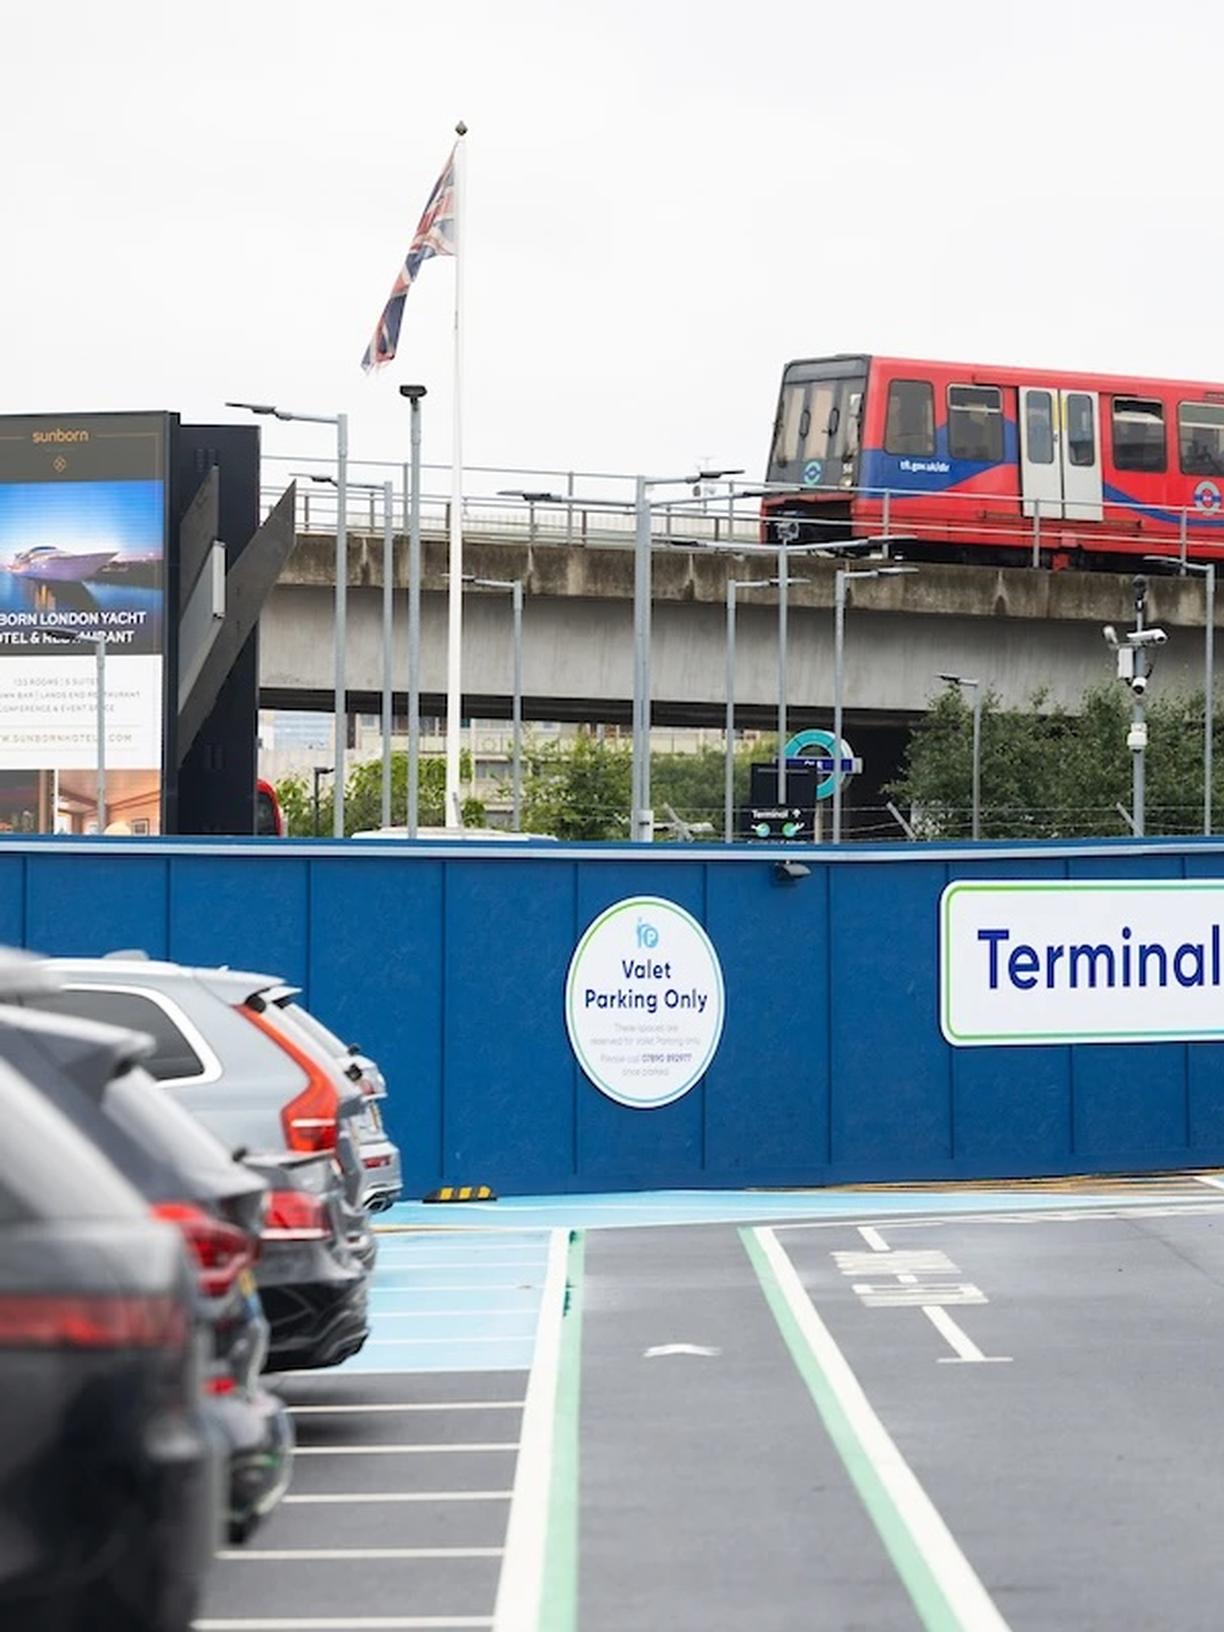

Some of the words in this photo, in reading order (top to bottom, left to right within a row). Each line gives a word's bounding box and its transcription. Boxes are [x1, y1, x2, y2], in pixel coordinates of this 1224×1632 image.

[32, 428, 89, 443] sunborn
[40, 612, 99, 626] LONDON
[99, 611, 147, 625] YACHT
[30, 631, 40, 644] &
[752, 808, 789, 819] Terminal
[977, 924, 1221, 991] Terminal
[622, 959, 671, 979] Valet
[585, 988, 657, 1013] Parking
[664, 988, 708, 1013] Only
